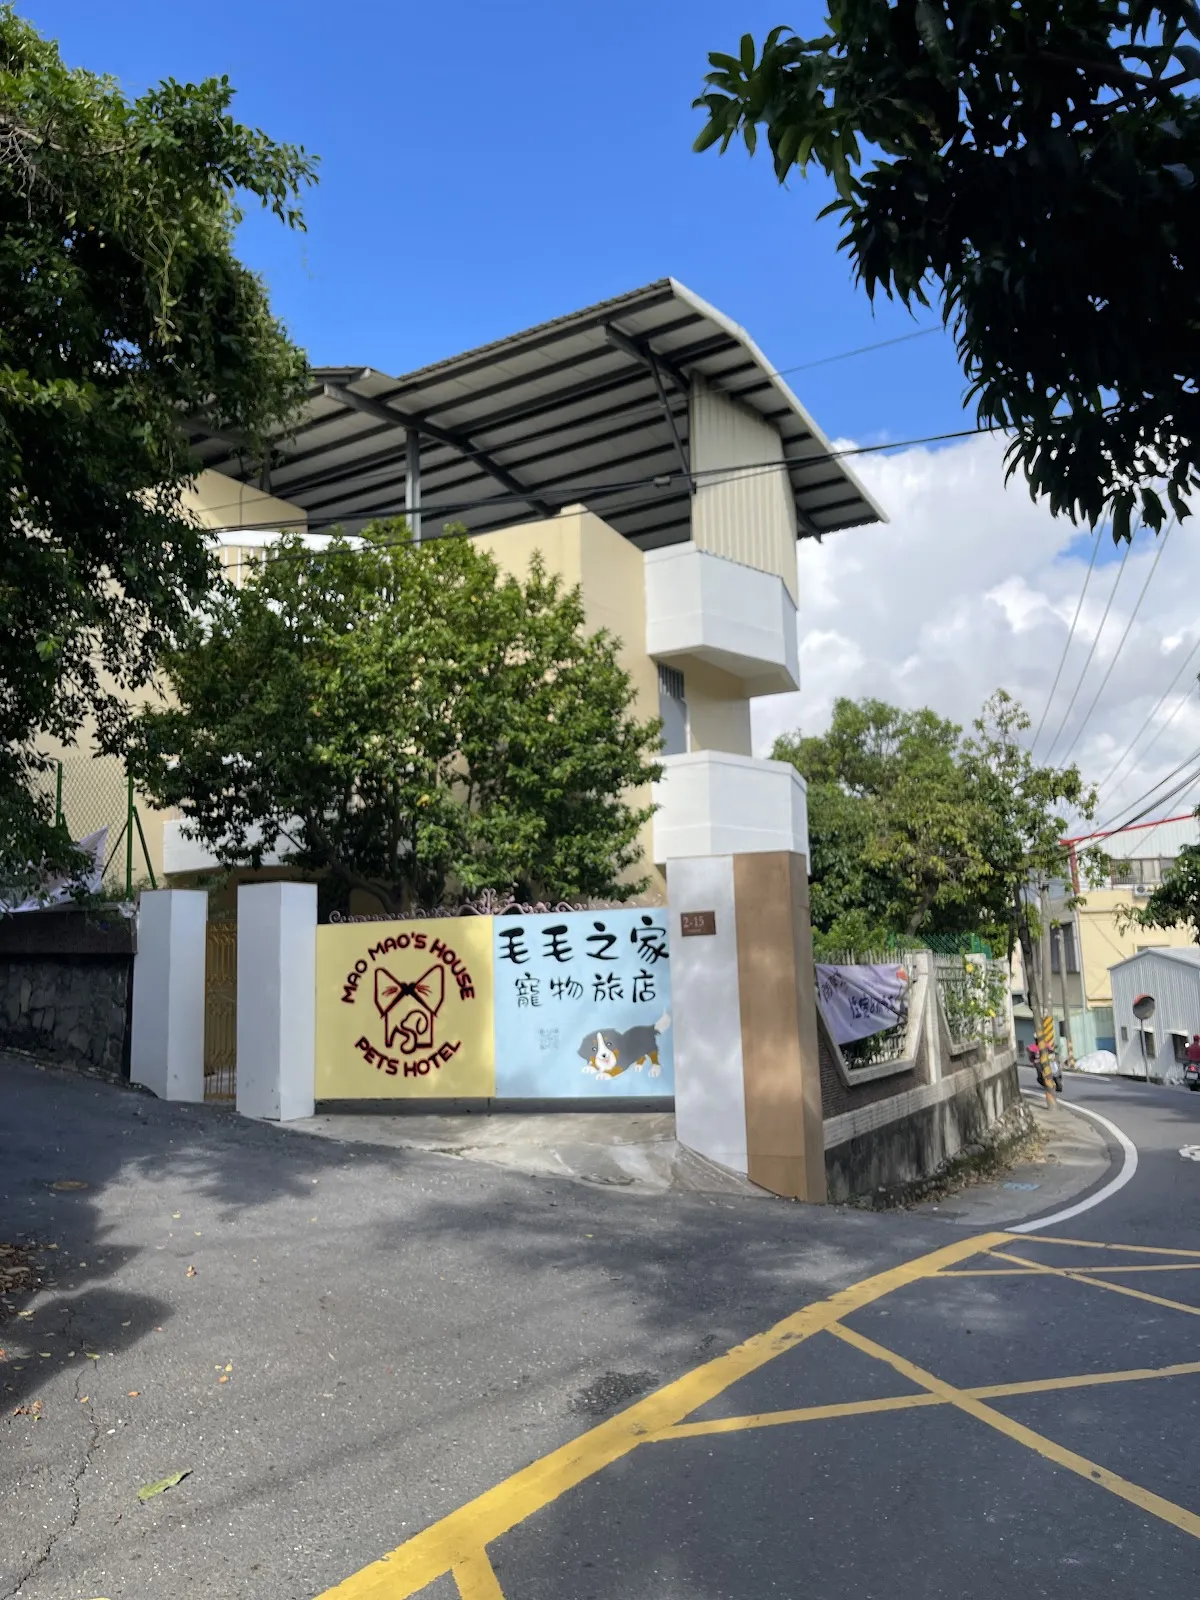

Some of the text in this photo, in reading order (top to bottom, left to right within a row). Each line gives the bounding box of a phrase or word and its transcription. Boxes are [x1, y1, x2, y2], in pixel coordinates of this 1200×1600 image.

[498, 915, 669, 965] 毛毛之家
[341, 931, 475, 1004] MAO MAO'S HOUSE
[515, 969, 656, 1008] 寵物旅店
[354, 1036, 462, 1077] PETS HOTEL
